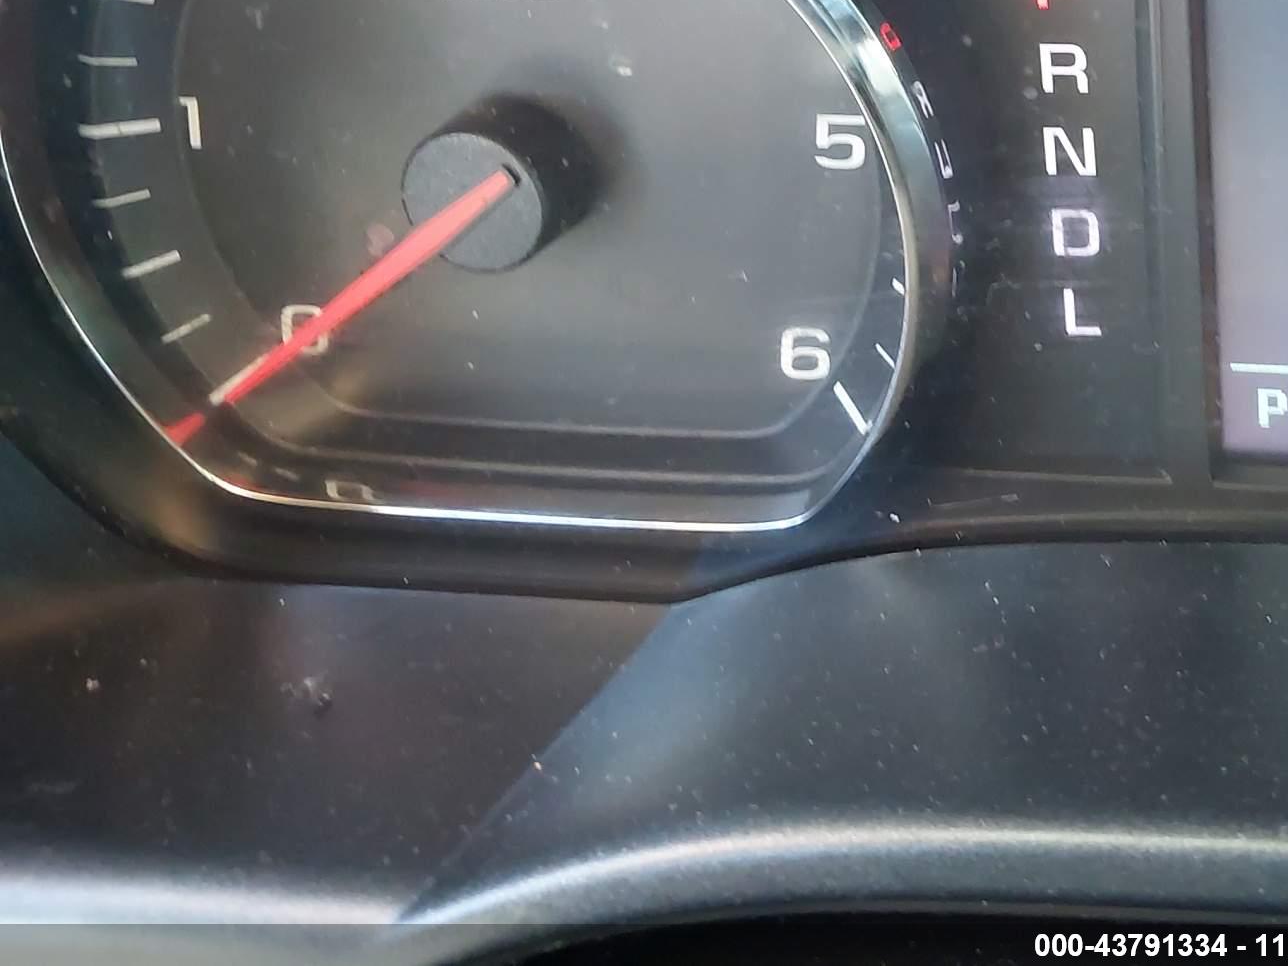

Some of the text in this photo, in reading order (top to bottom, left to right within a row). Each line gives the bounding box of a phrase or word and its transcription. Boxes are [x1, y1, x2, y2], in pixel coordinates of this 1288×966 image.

[1039, 43, 1089, 94] R
[179, 96, 202, 149] 1
[814, 113, 866, 170] 5
[1043, 127, 1097, 176] N
[1051, 208, 1100, 256] D
[281, 304, 328, 354] 0
[1063, 288, 1102, 336] L
[781, 328, 830, 379] 6
[1257, 388, 1288, 428] P
